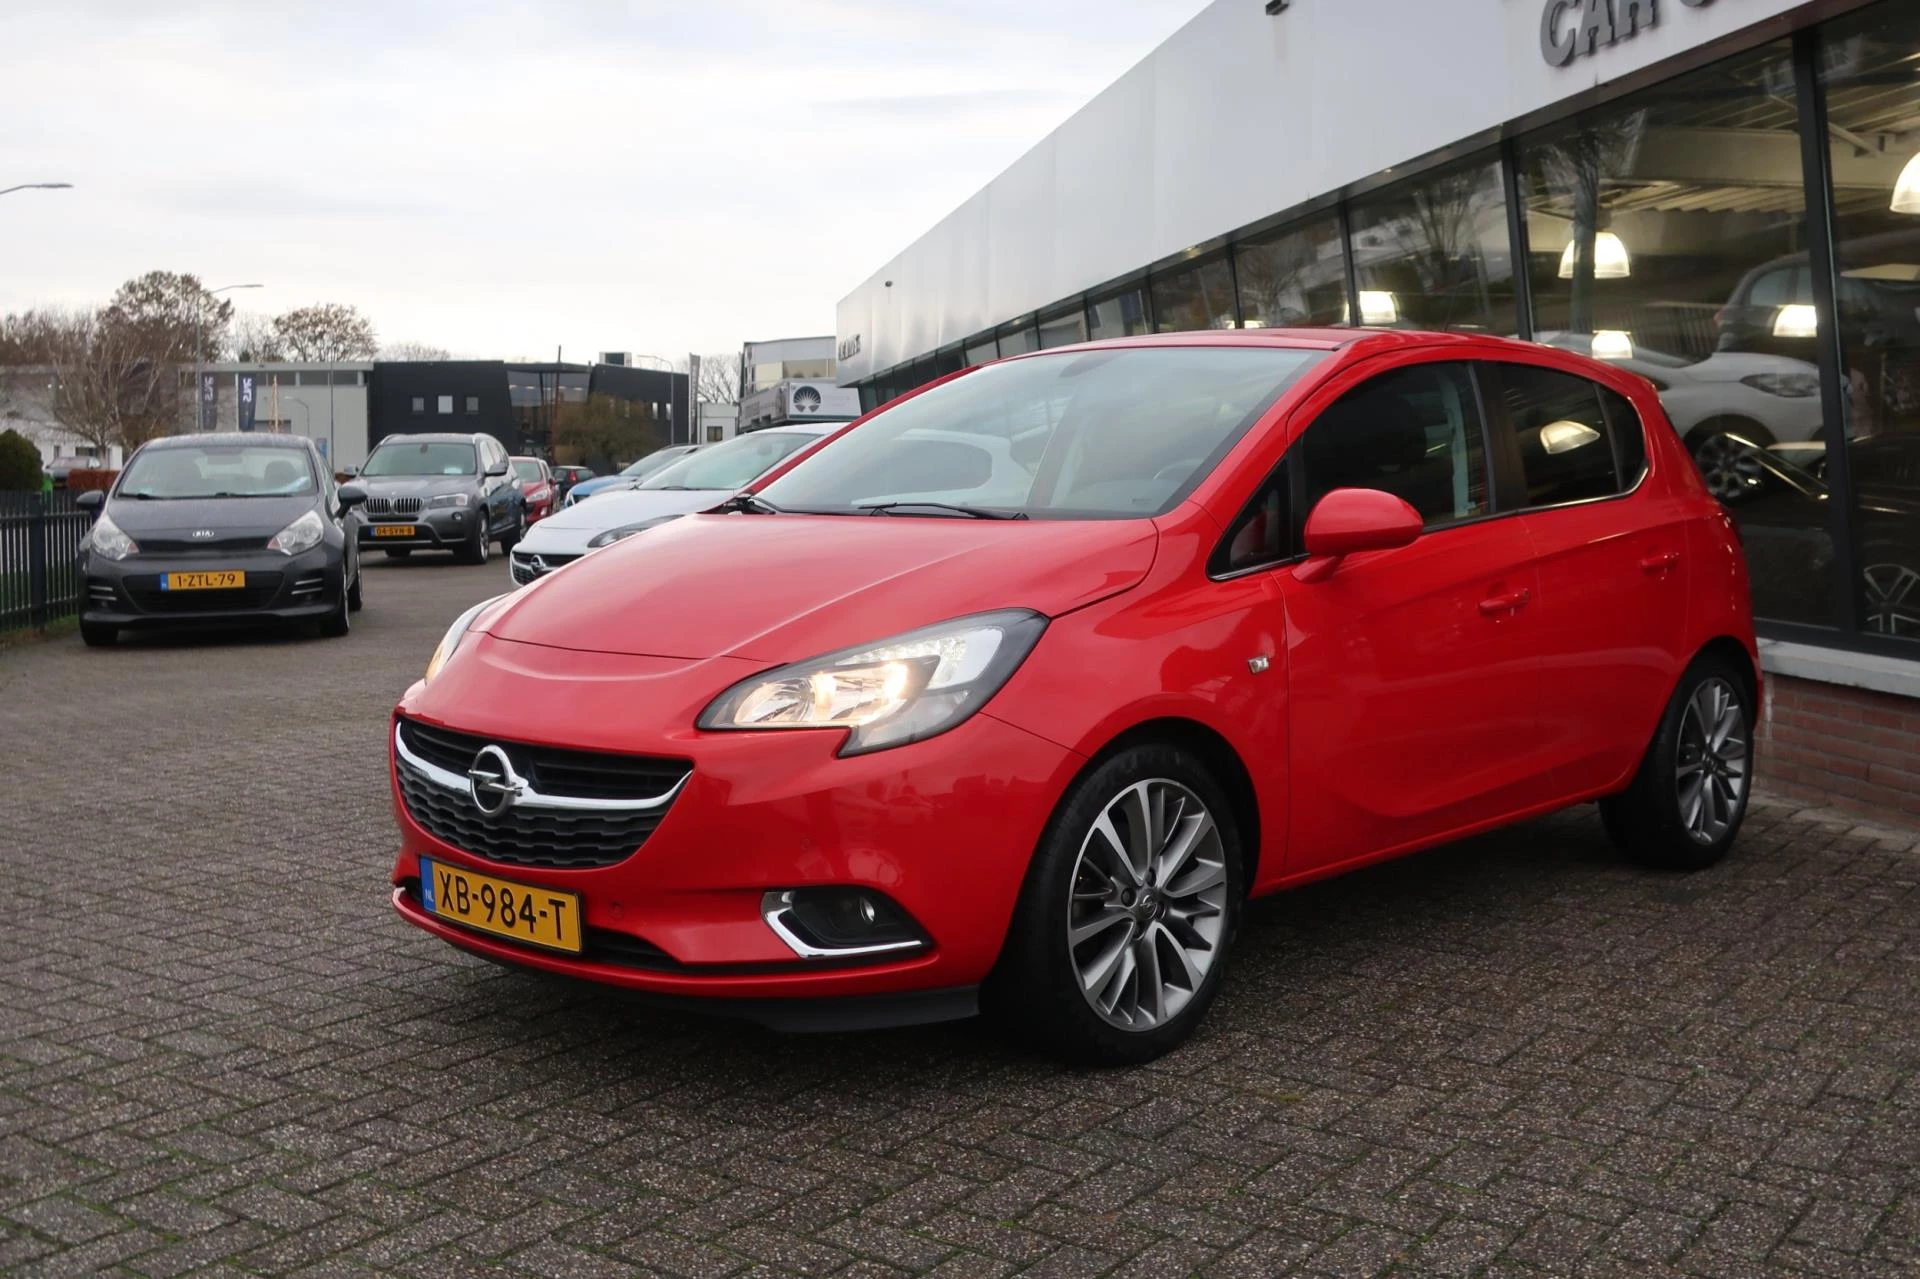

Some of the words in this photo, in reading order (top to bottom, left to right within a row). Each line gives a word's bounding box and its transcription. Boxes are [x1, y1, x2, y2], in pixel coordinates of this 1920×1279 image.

[177, 574, 236, 587] 1-ZTL-79
[424, 888, 434, 902] NL
[439, 870, 566, 940] XB-984-T
